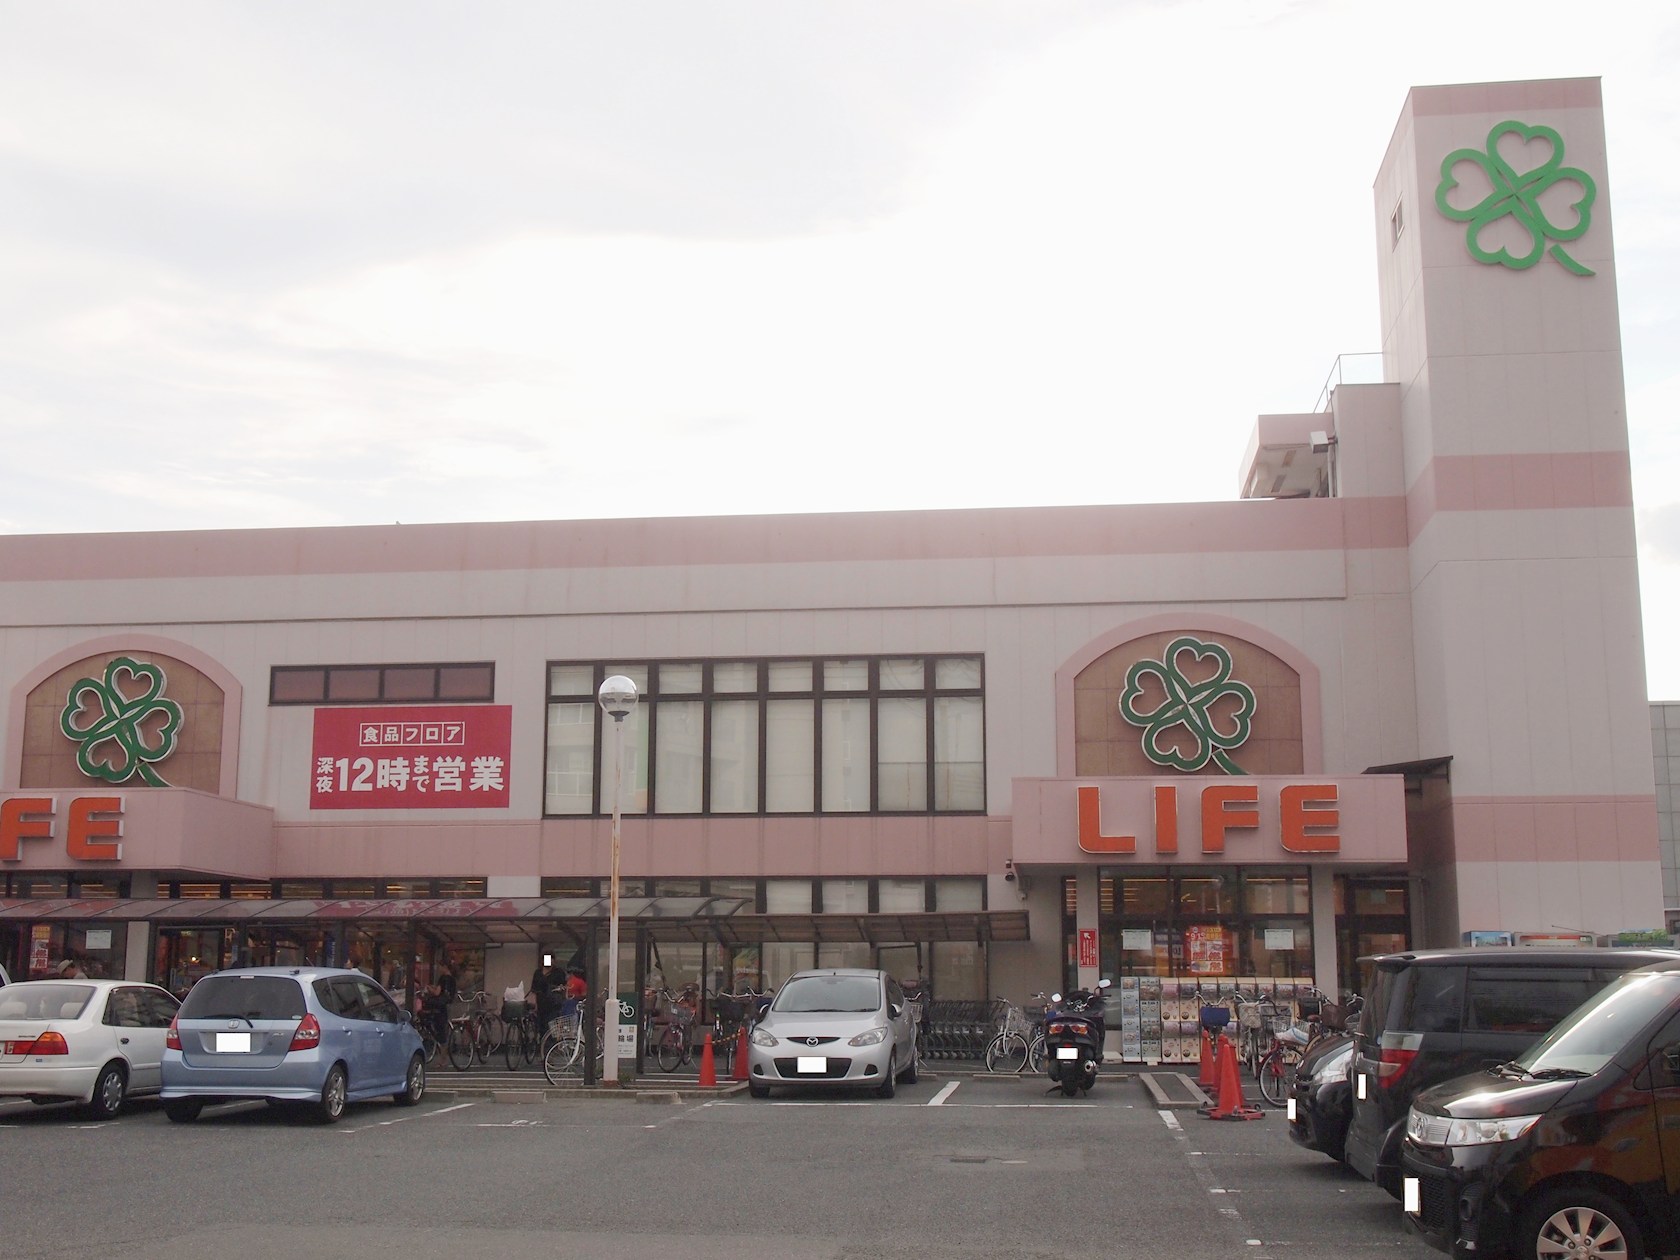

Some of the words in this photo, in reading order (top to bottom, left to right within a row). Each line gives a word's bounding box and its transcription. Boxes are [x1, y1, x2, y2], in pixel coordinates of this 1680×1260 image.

[363, 726, 461, 743] 食品フロア
[1077, 784, 1341, 854] LIFE
